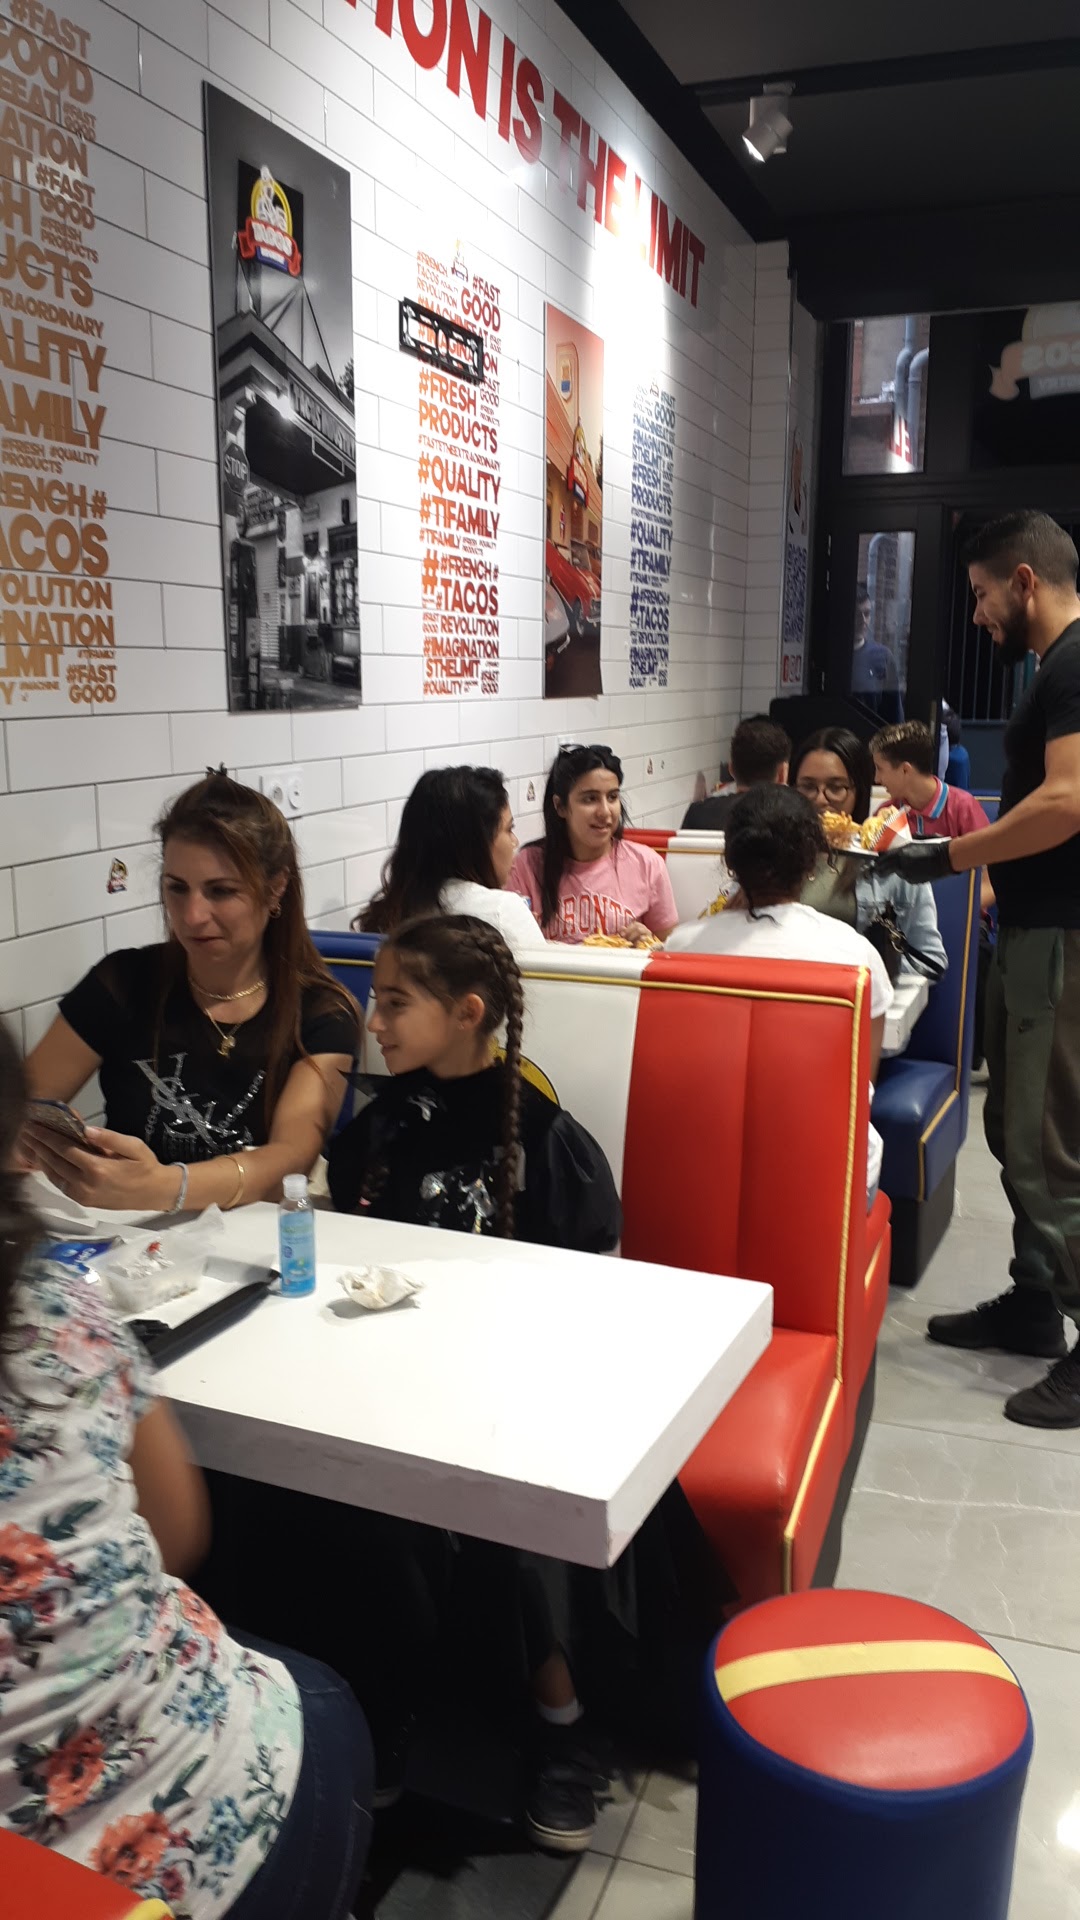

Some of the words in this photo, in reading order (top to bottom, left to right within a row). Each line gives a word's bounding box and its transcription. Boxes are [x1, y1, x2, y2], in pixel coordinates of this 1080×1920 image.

[10, 0, 91, 60] #FAST
[344, 0, 491, 122] ON
[498, 34, 545, 165] IS
[553, 87, 627, 238] THE
[36, 163, 96, 209] #FAST
[40, 188, 96, 230] GOOD
[461, 285, 501, 333] GOOD
[472, 273, 501, 307] #FAST
[419, 366, 477, 417] #FRESH
[419, 397, 498, 455] PRODUCTS
[654, 400, 676, 429] GOOD
[224, 454, 250, 481] STOP
[418, 450, 502, 506] #QUALITY
[631, 462, 662, 492] #FRESH
[631, 482, 672, 517] PRODUCTS
[630, 518, 673, 552] #QUALITY
[440, 614, 500, 638] REVOLUTION
[66, 663, 118, 684] #FAST
[69, 684, 117, 704] GOOD
[546, 893, 637, 941] RONT
